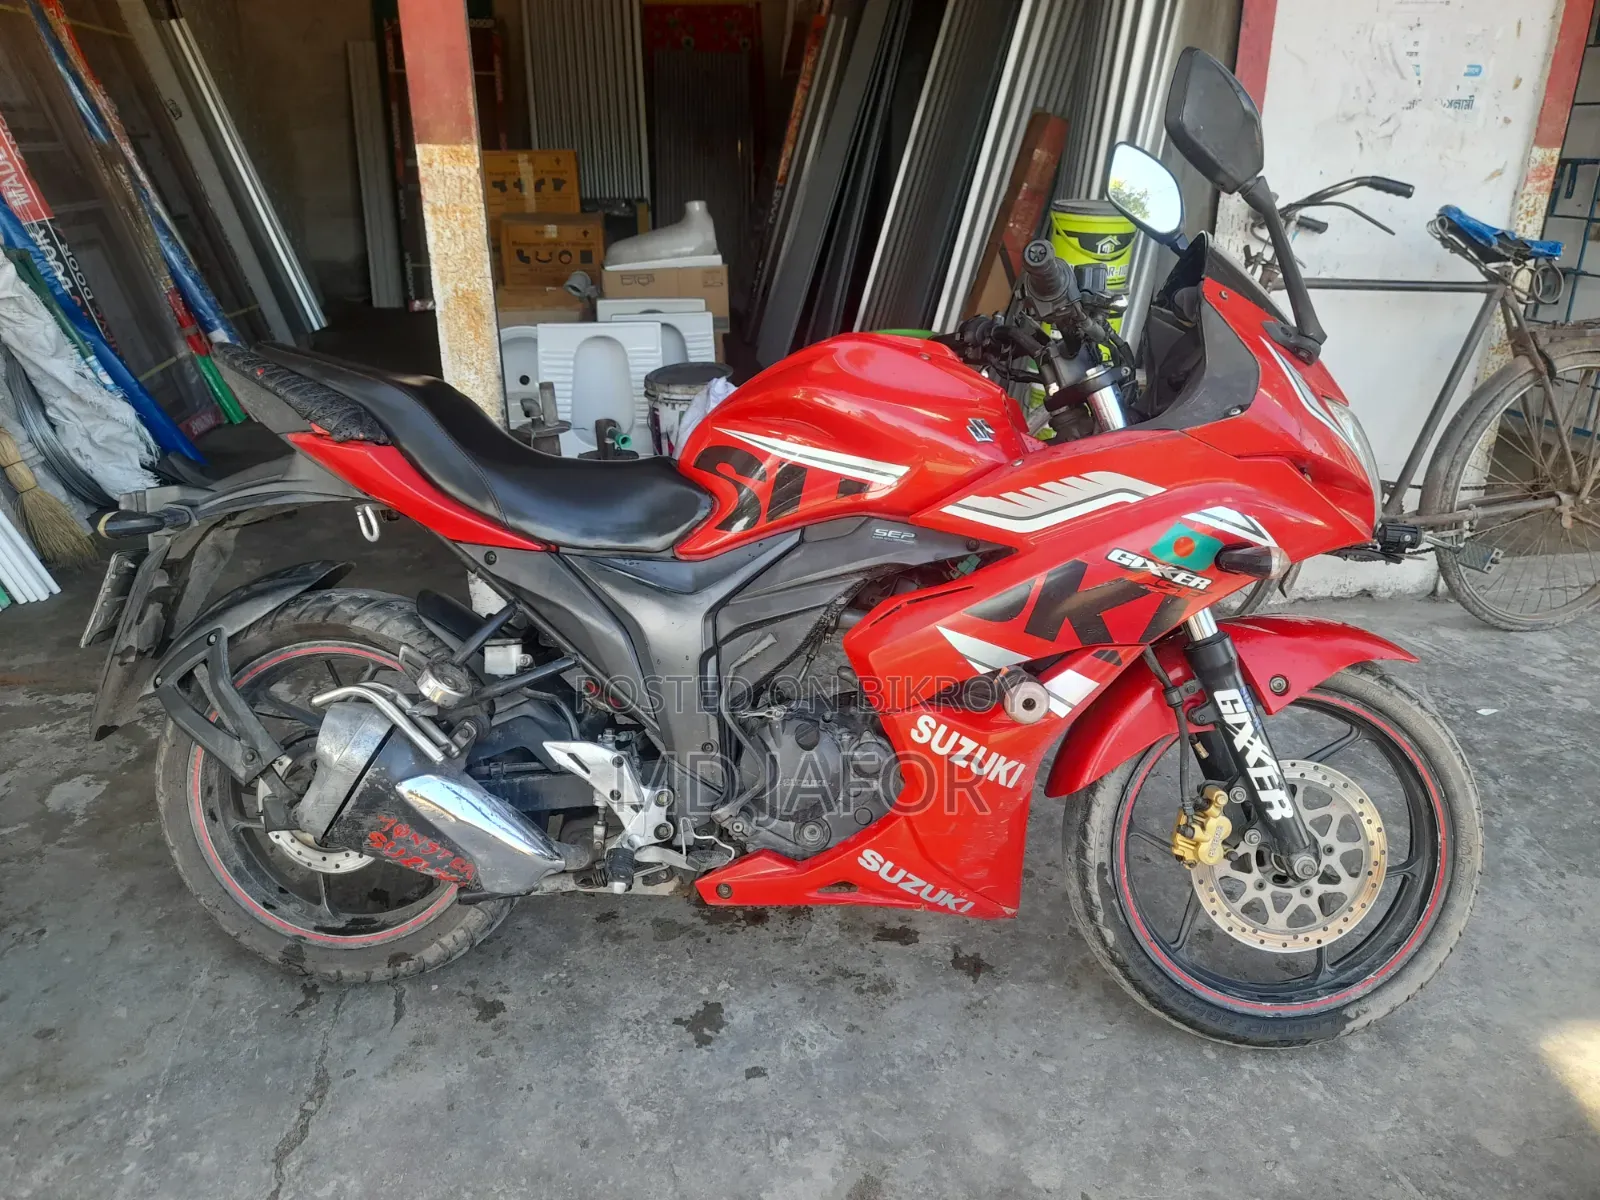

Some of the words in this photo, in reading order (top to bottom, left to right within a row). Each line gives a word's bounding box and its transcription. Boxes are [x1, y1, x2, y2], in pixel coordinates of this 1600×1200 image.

[60, 243, 94, 300] DOOR
[873, 528, 916, 539] SEP
[1106, 548, 1213, 590] GIXXER
[910, 714, 1027, 789] SUZUKI
[1214, 688, 1294, 821] GIXXER
[858, 848, 975, 913] SUZUKI
